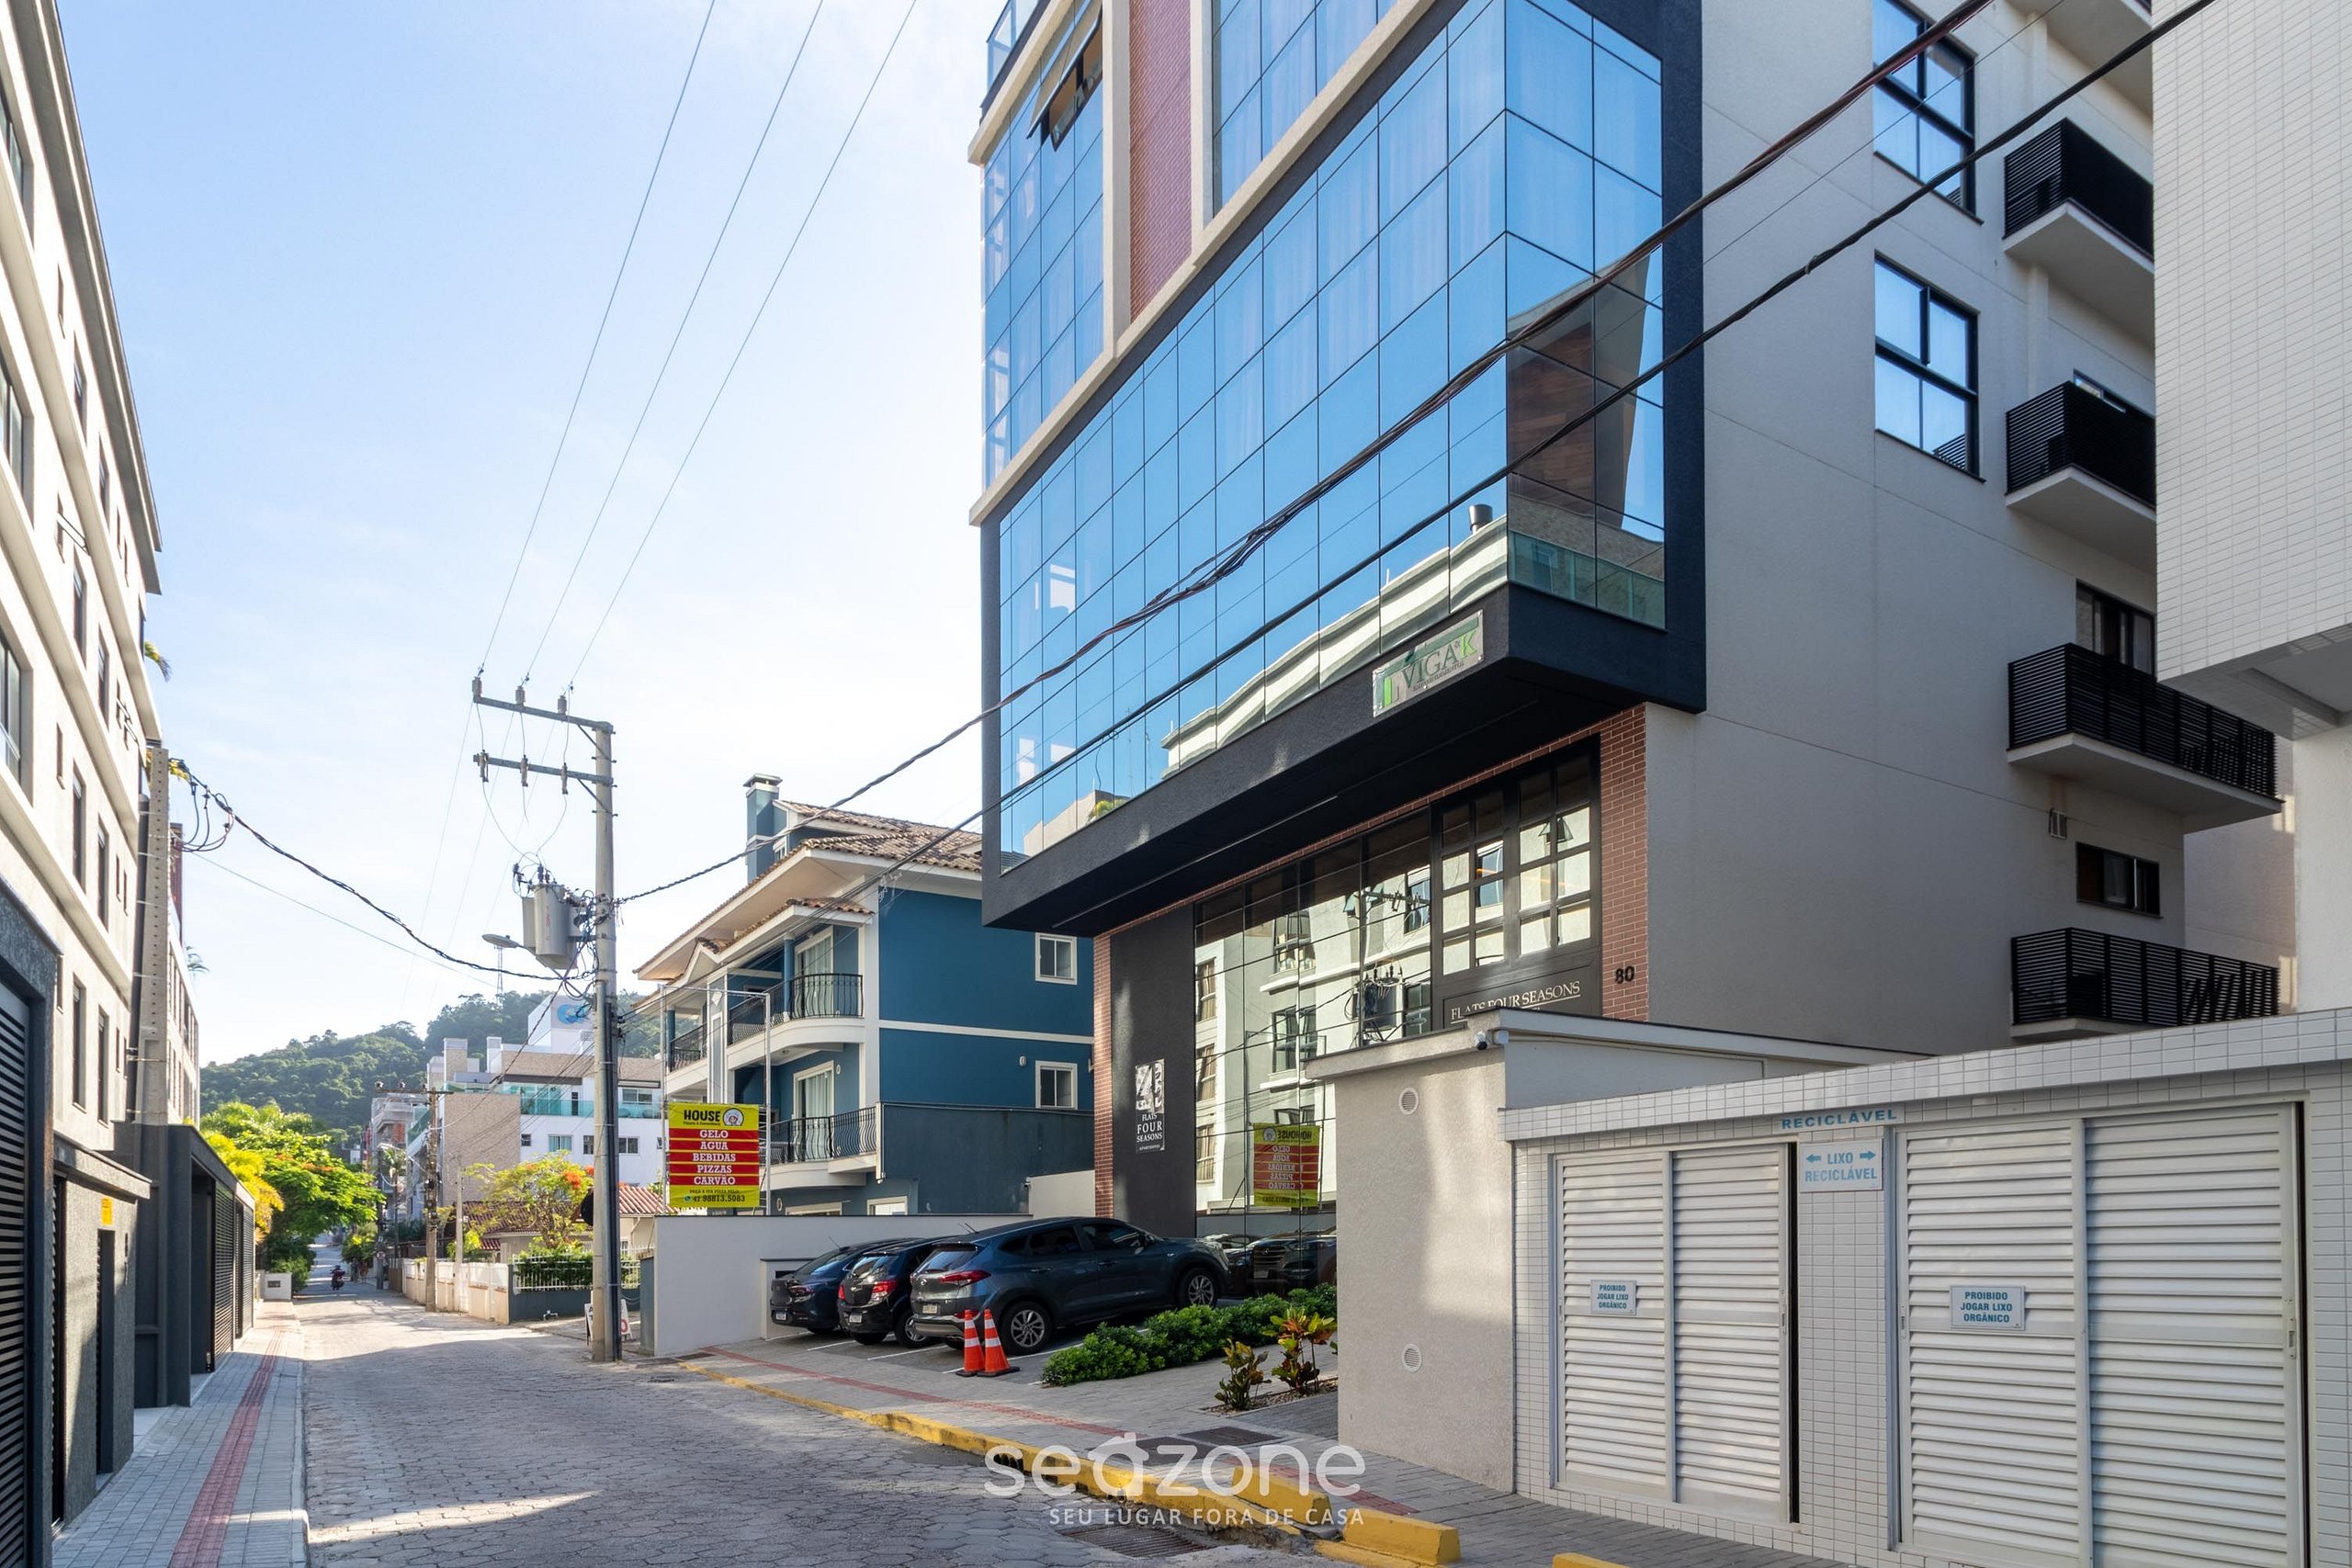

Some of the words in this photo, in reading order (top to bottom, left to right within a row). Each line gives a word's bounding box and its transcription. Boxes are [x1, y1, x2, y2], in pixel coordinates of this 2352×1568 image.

[1614, 965, 1635, 984] 80
[1521, 980, 1580, 1005] SEASONS
[684, 1110, 720, 1122] HOUSE
[1782, 1109, 1897, 1129] RECICLÁVEL
[1137, 1121, 1162, 1134] FOUR
[700, 1130, 729, 1138] GELO
[1136, 1132, 1162, 1142] SEASONS
[700, 1139, 729, 1150] ÁGUA
[693, 1153, 736, 1162] BEBIDAS
[1827, 1152, 1853, 1165] LIXO
[697, 1165, 732, 1174] PIZZAS
[1804, 1167, 1877, 1182] RECICLÁVEL
[694, 1174, 736, 1185] CARVÃO
[1964, 1292, 2007, 1300] PROIBIDO
[1961, 1303, 1989, 1311] JOGAR
[1992, 1303, 2012, 1312] LIXO
[1963, 1313, 2009, 1323] ORGÂNICO
